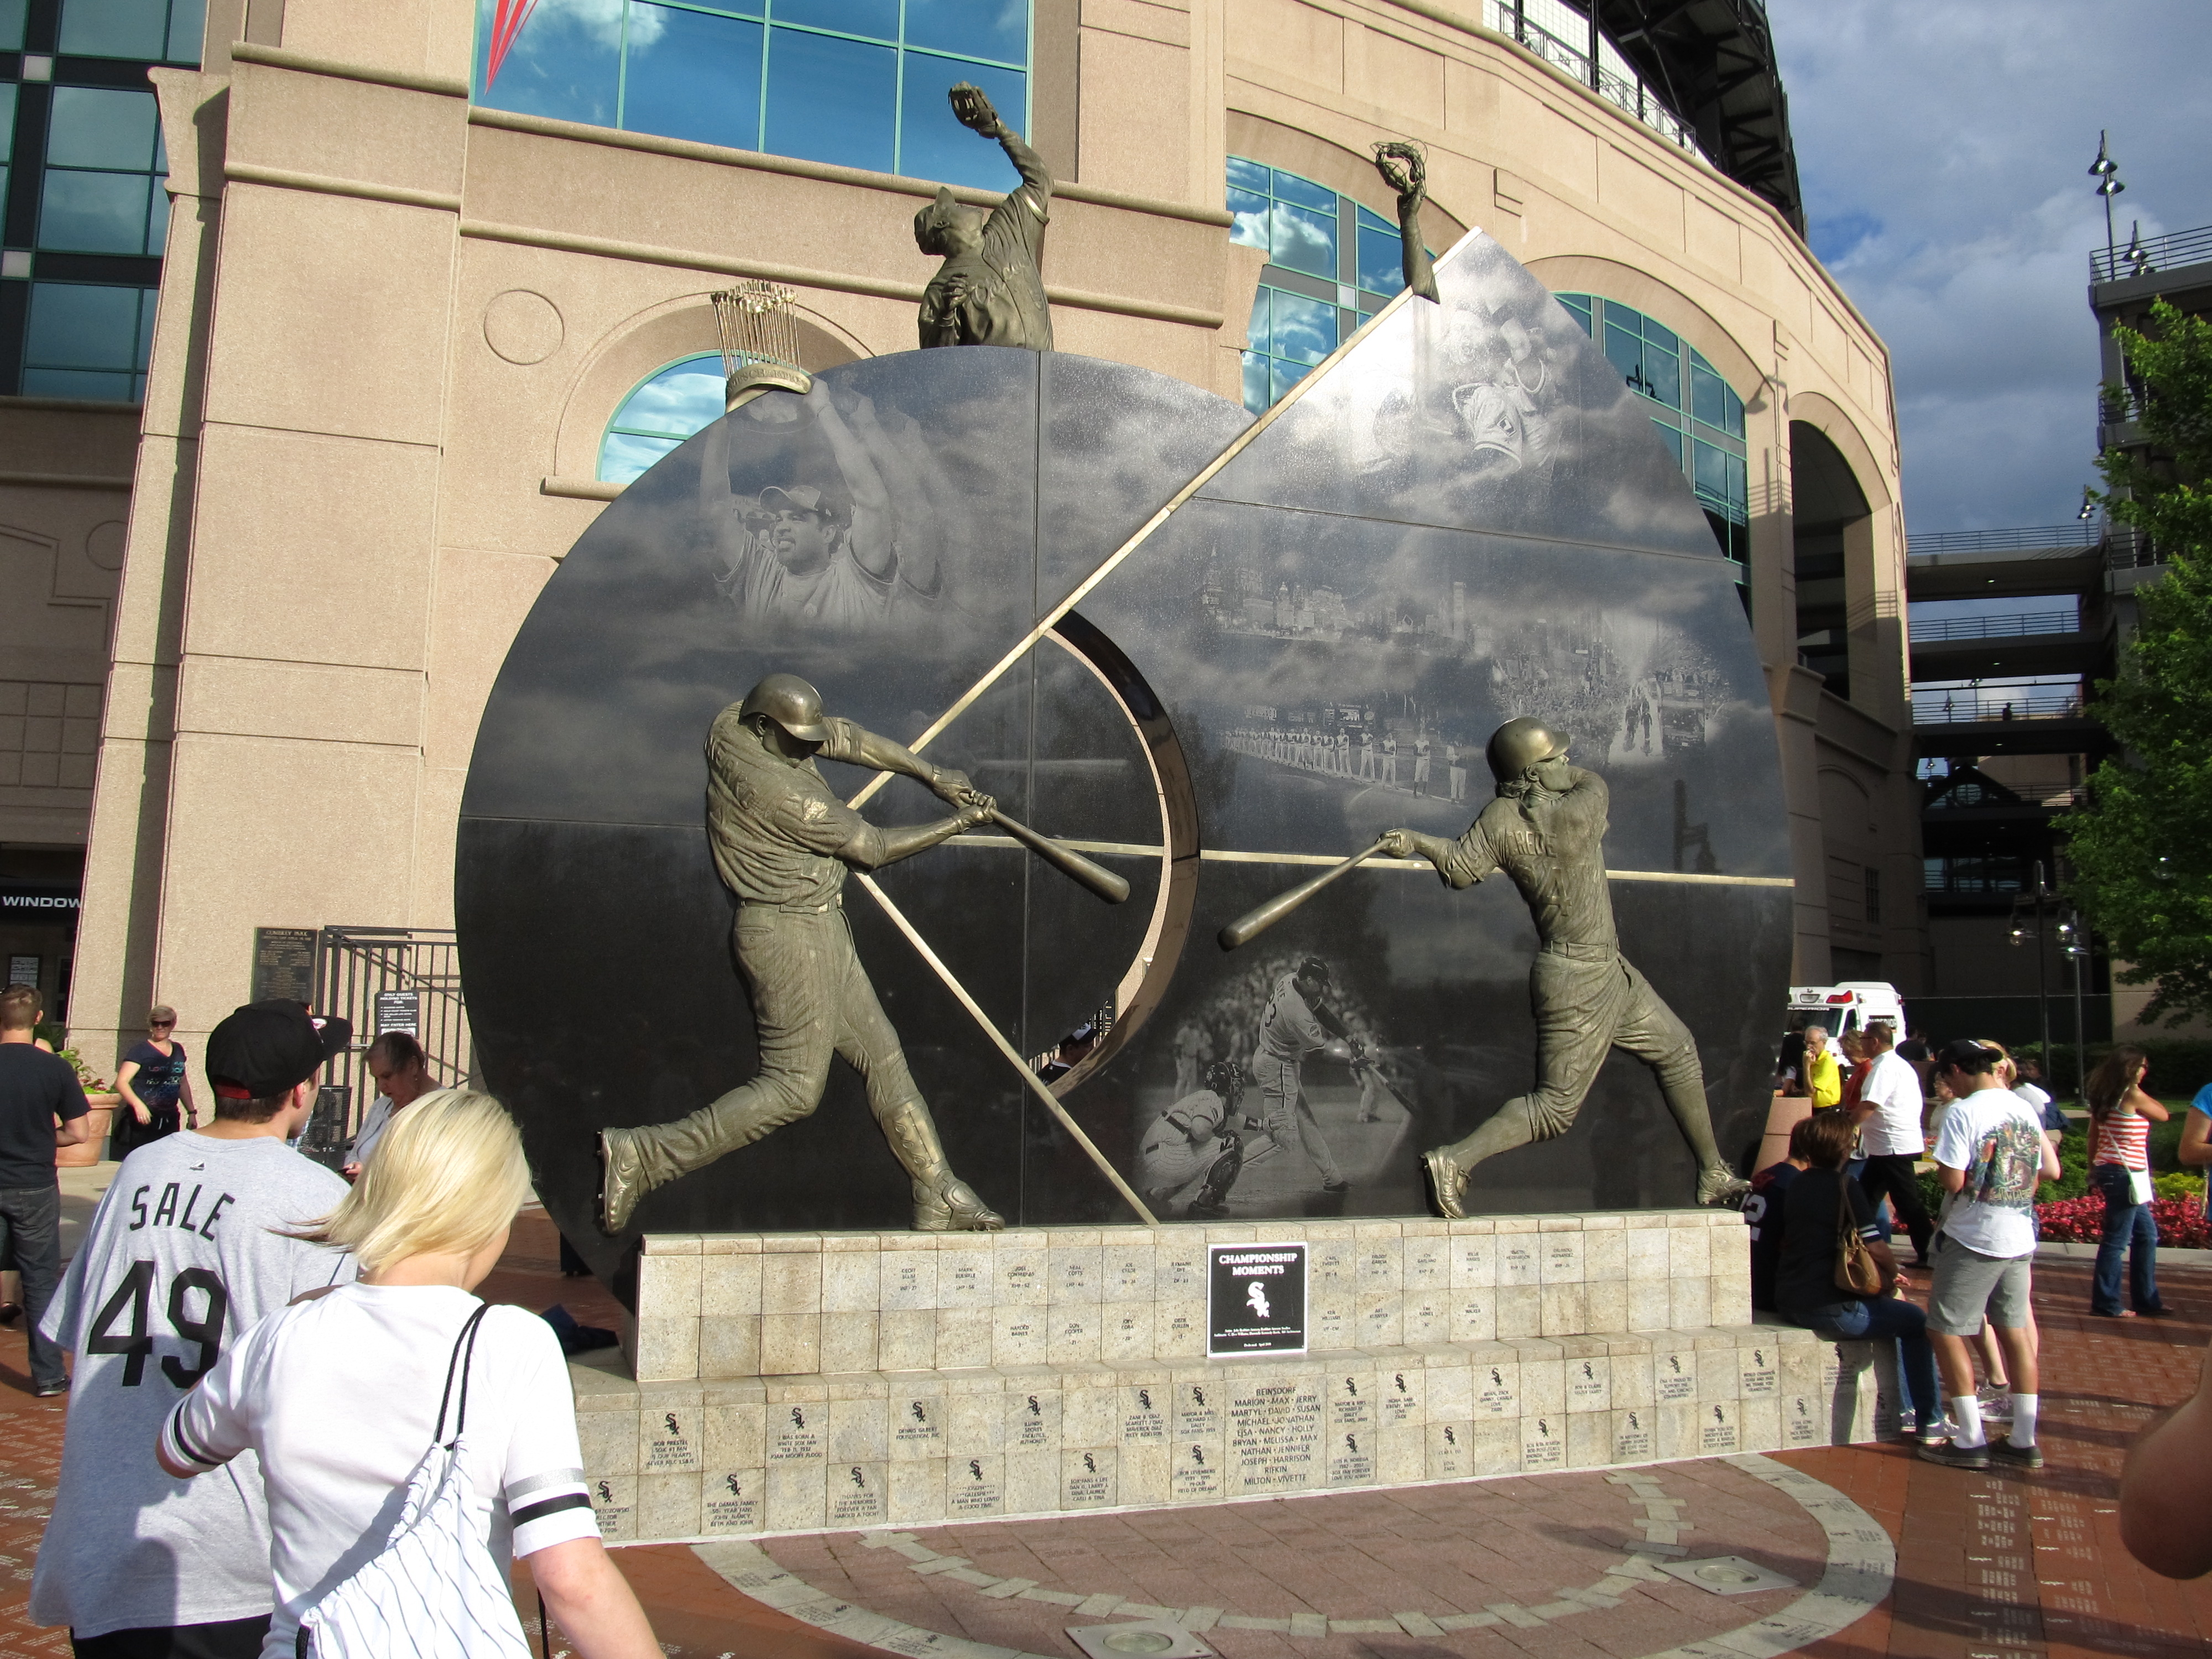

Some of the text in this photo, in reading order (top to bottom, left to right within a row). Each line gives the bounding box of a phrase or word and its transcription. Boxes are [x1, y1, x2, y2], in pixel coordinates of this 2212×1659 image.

[130, 1182, 236, 1242] SALE
[1219, 1253, 1297, 1264] CHAMPIONSHIP
[1232, 1265, 1285, 1276] MOMENTS
[87, 1260, 227, 1389] 49
[1256, 1387, 1296, 1396] REINSDORF
[1235, 1399, 1265, 1407] MARION
[1296, 1395, 1317, 1404] JERRY
[1237, 1415, 1314, 1427] MICHAEL JONATHAN
[1259, 1427, 1286, 1435] NANCY
[1233, 1438, 1257, 1447] BRYAN
[1264, 1436, 1293, 1444] MELISSA
[1241, 1444, 1310, 1456] NATHAN JENNIFER
[1241, 1454, 1311, 1466] JOSEPH HARRISON
[1265, 1465, 1287, 1474] RIFKIN
[1244, 1474, 1306, 1485] MILTON VIVETTE
